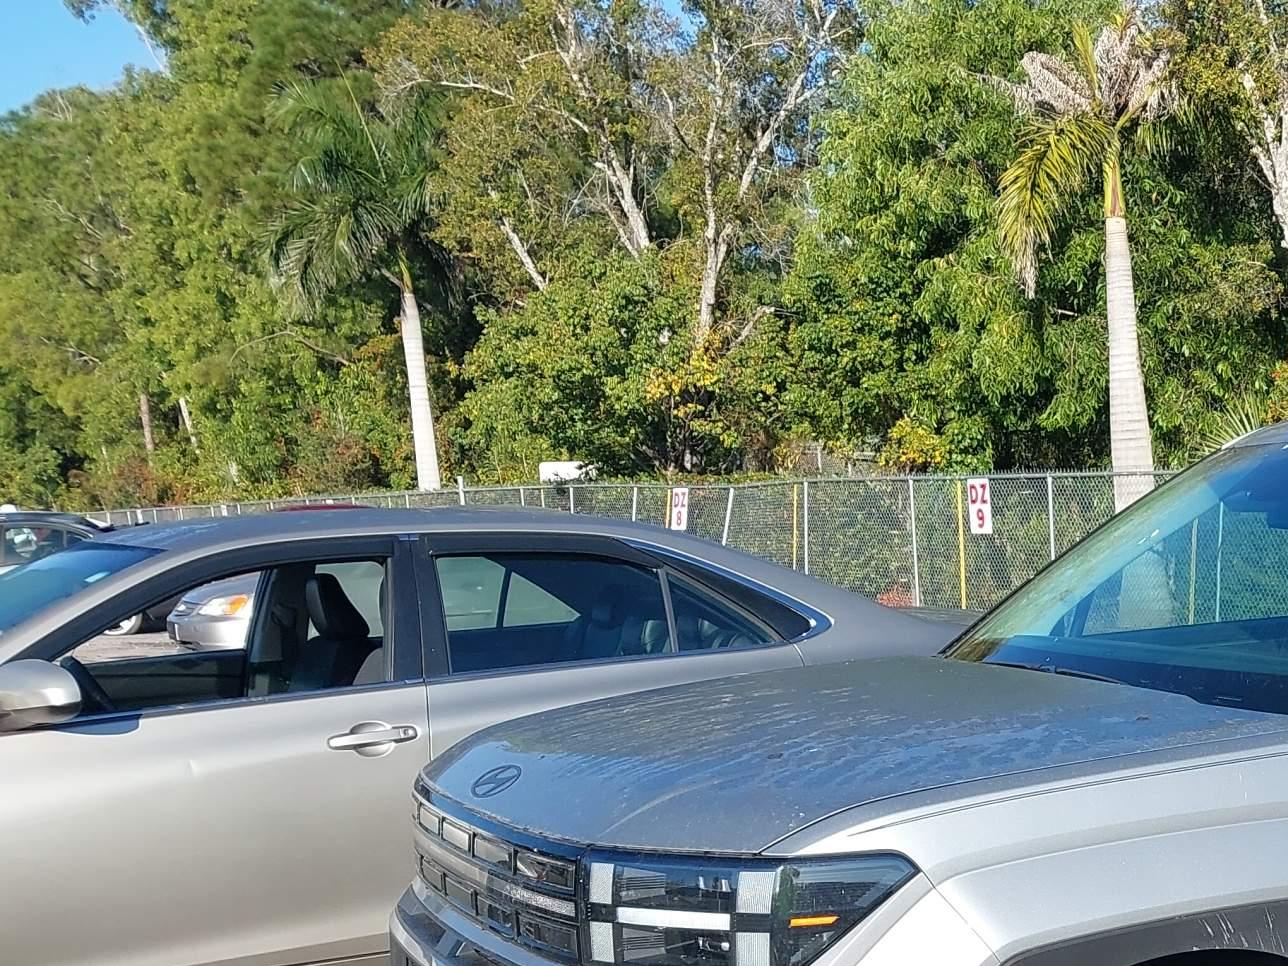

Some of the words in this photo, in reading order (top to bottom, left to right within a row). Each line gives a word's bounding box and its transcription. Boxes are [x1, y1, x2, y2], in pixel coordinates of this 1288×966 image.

[673, 491, 687, 508] DZ
[969, 483, 988, 505] DZ
[676, 511, 682, 527] 8
[976, 508, 985, 529] 9
